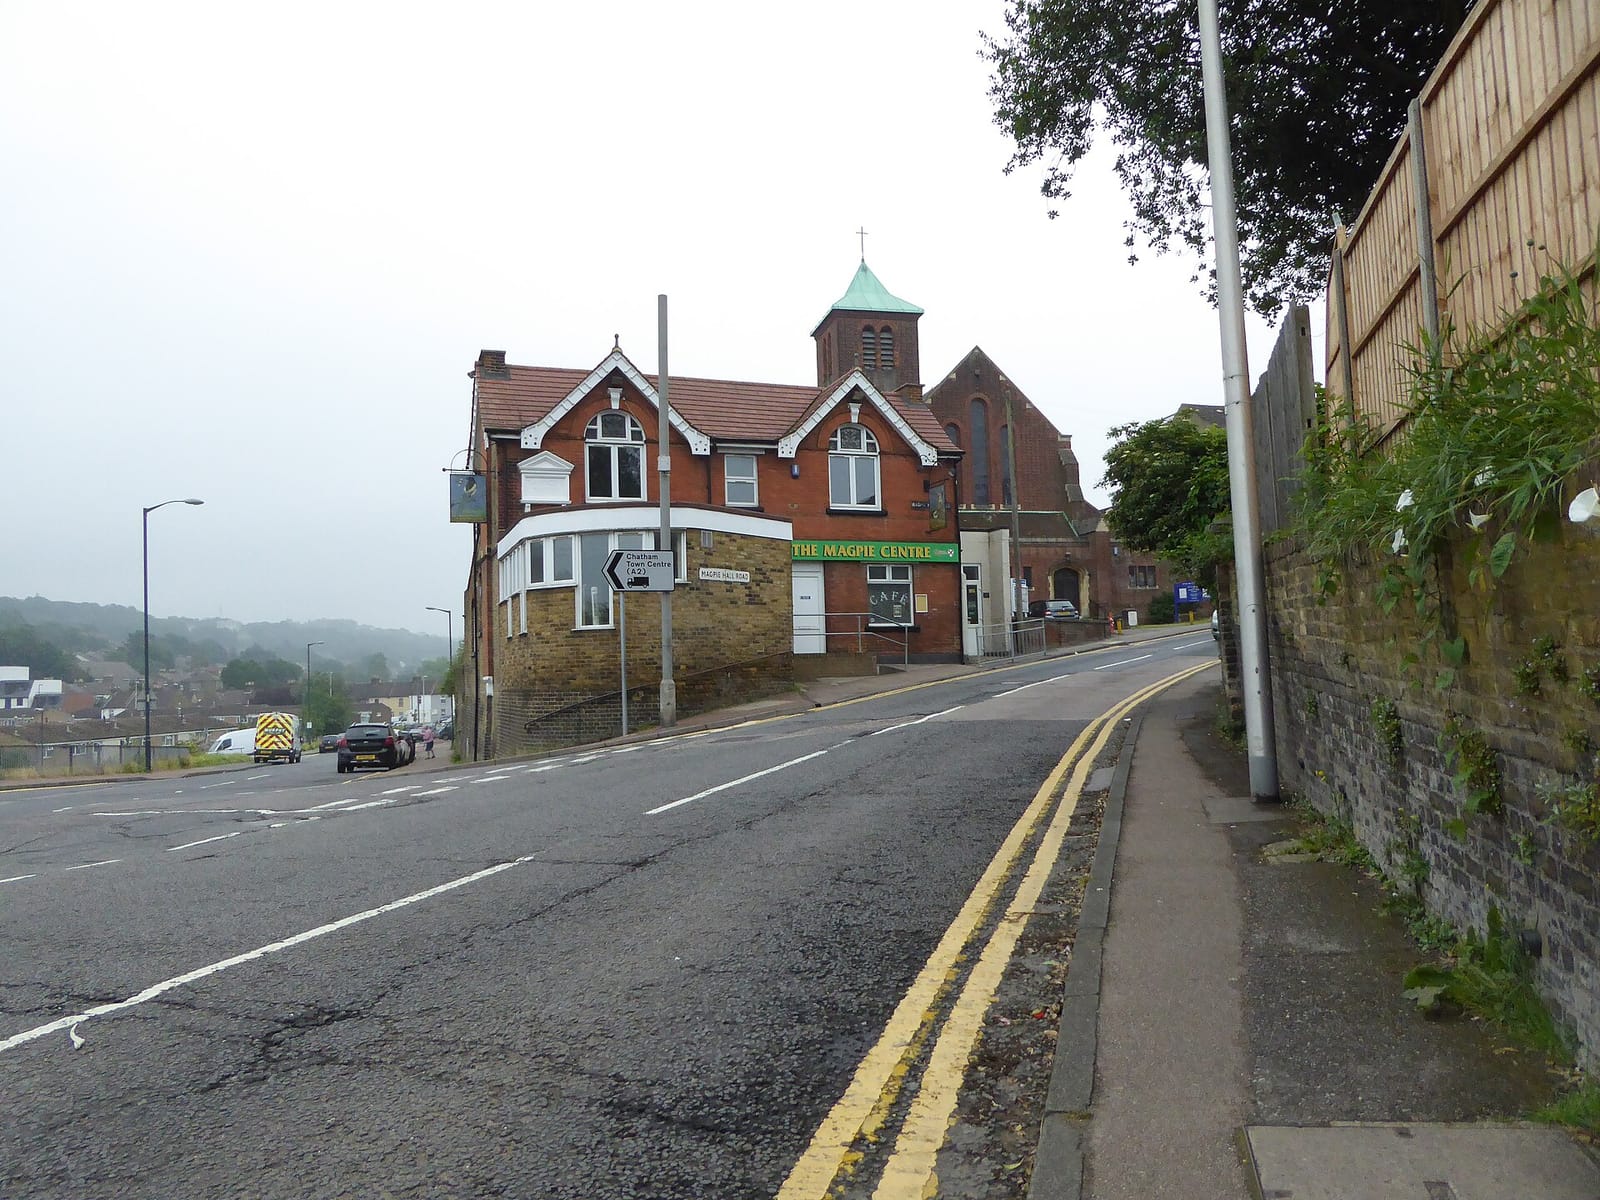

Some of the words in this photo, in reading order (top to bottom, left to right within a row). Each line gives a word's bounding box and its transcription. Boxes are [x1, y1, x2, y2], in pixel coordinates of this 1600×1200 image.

[792, 544, 818, 556] THE
[824, 544, 875, 557] MAGPIE
[880, 545, 931, 558] CENTRE
[626, 568, 647, 576] (A2)
[701, 570, 721, 578] MAGPIE
